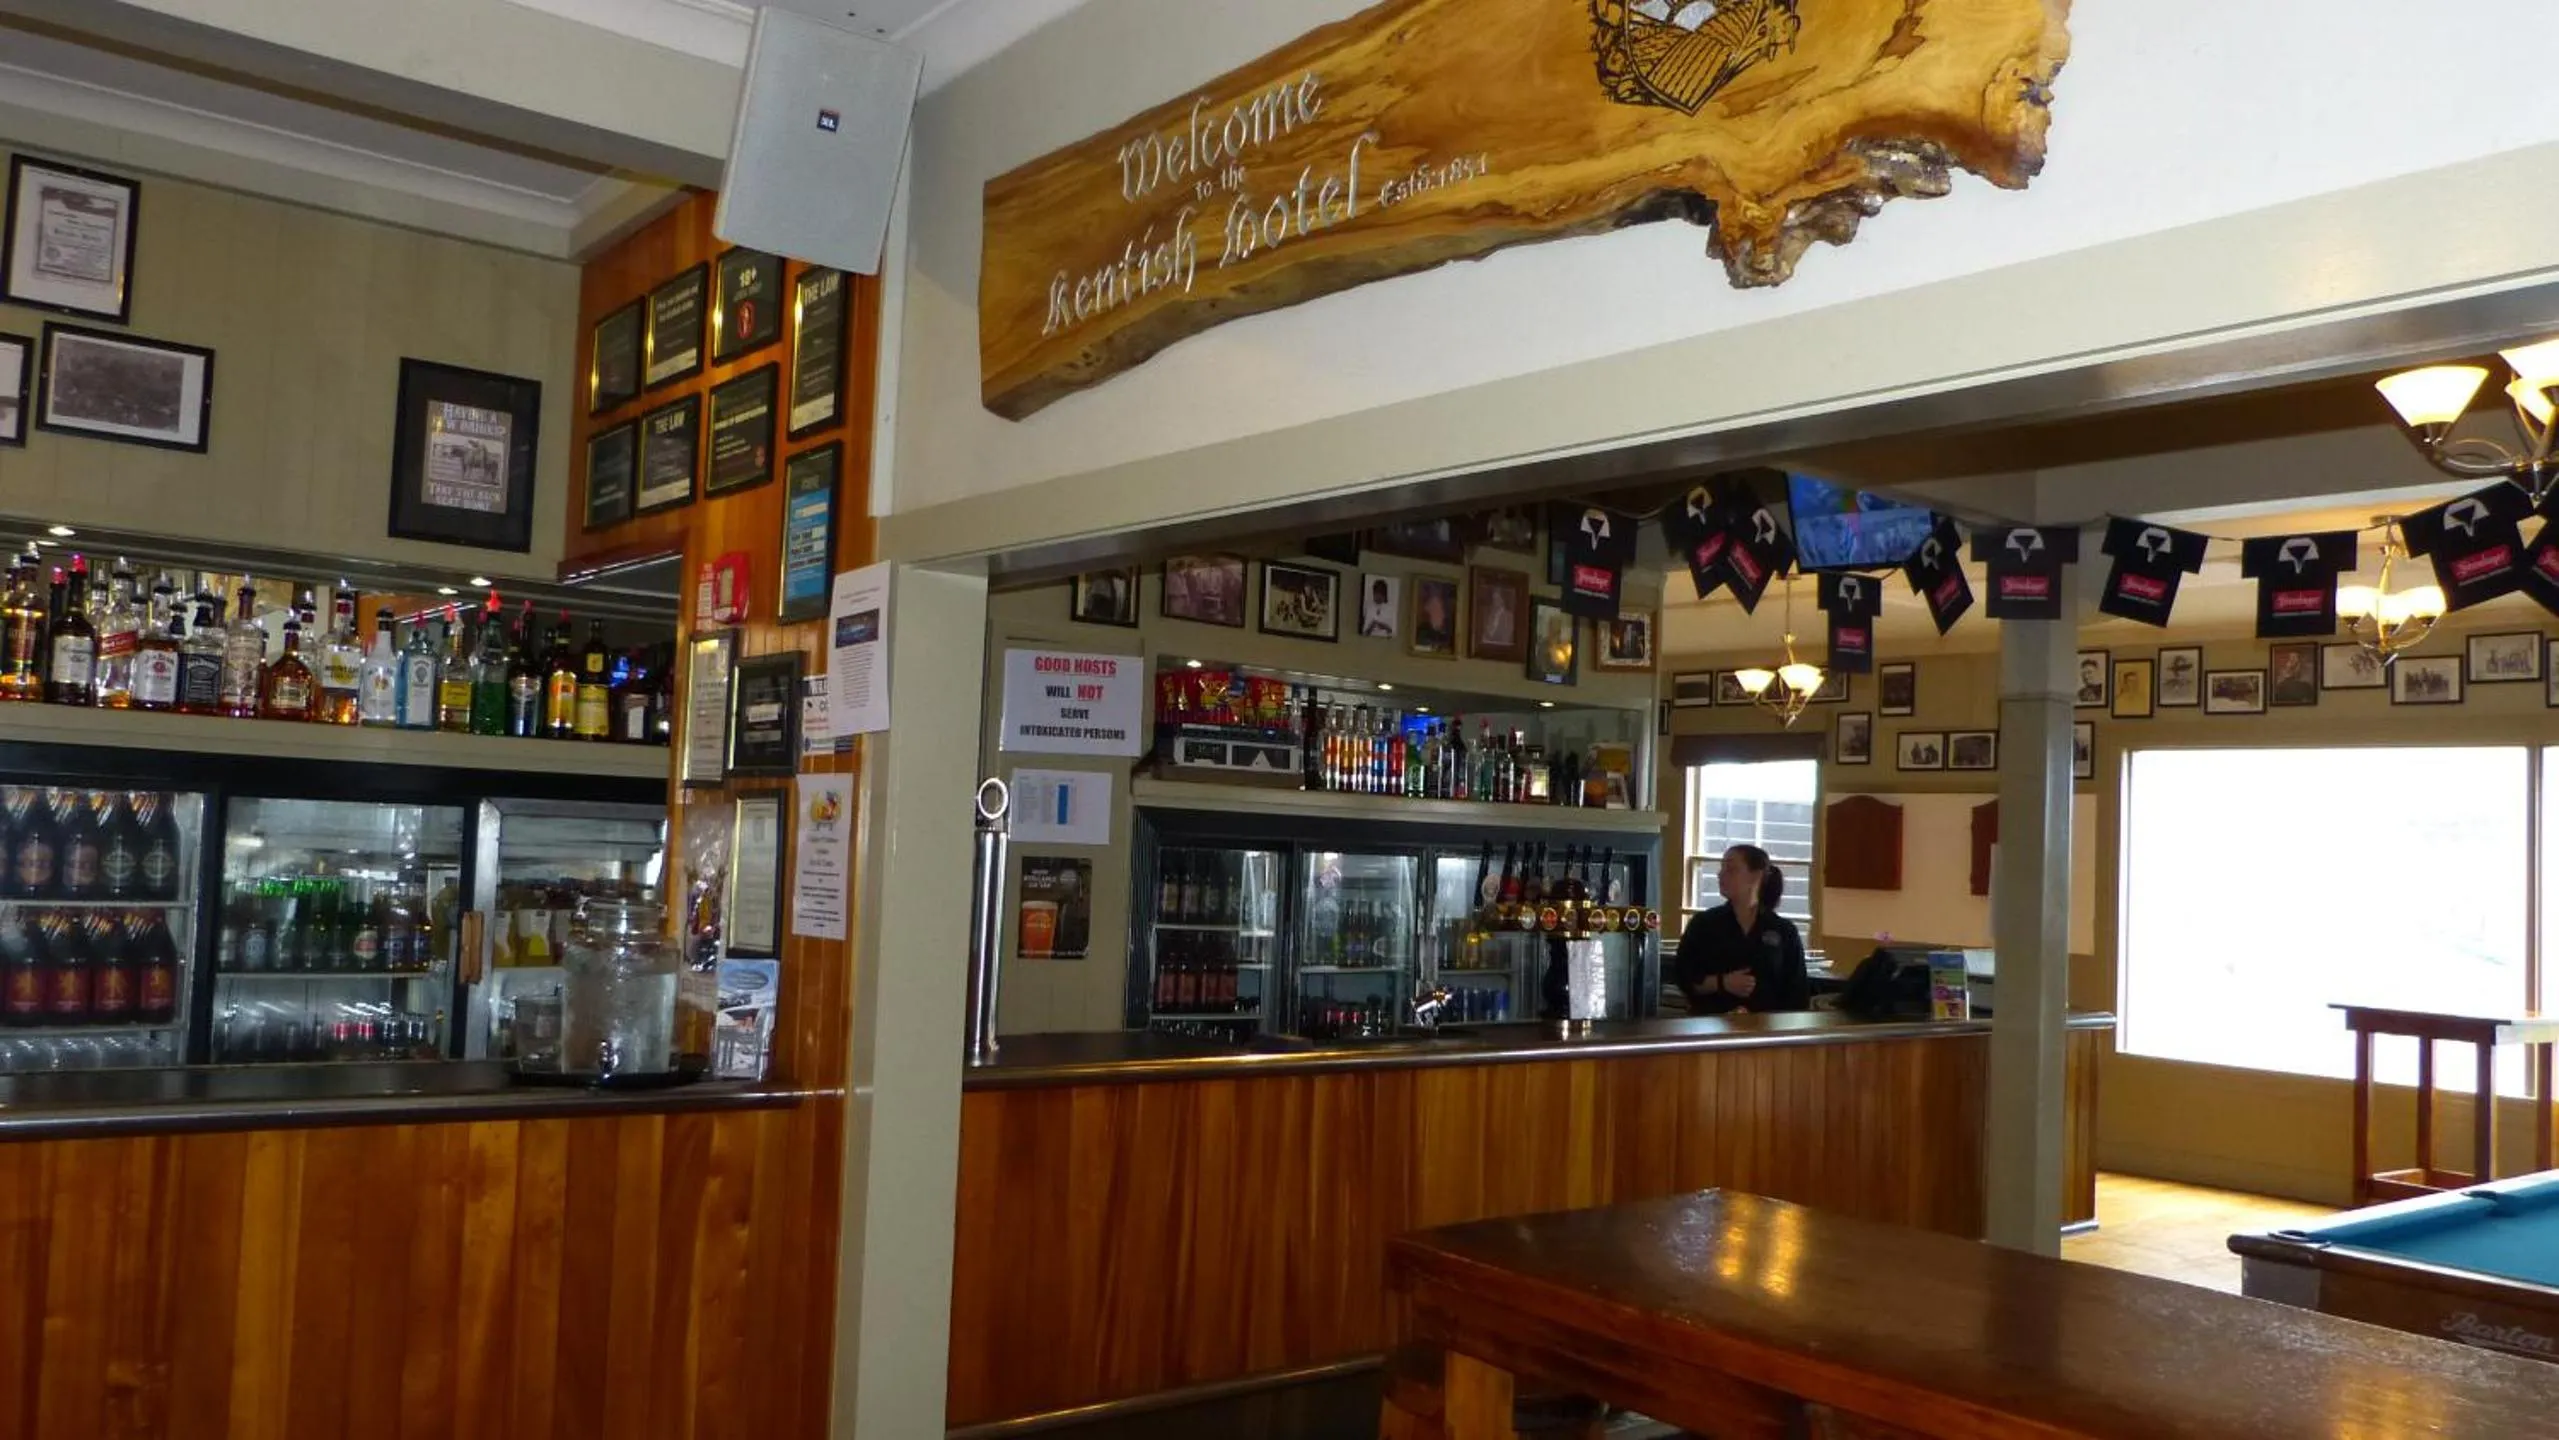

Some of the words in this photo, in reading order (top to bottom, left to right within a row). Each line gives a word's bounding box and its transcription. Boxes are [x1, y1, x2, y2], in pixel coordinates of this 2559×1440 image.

[1116, 71, 1322, 204] Welcome
[1195, 180, 1214, 201] to
[1220, 163, 1246, 191] the
[1041, 205, 1198, 338] Kentish
[1218, 130, 1381, 270] Hotel
[1034, 656, 1070, 672] GOOD
[1074, 658, 1117, 675] HOSTS
[1045, 685, 1071, 698] WILL
[1077, 684, 1104, 700] NOT
[1060, 707, 1090, 720] SERVE
[1020, 724, 1082, 738] INTOXICATED
[1083, 727, 1126, 741] PERSONS
